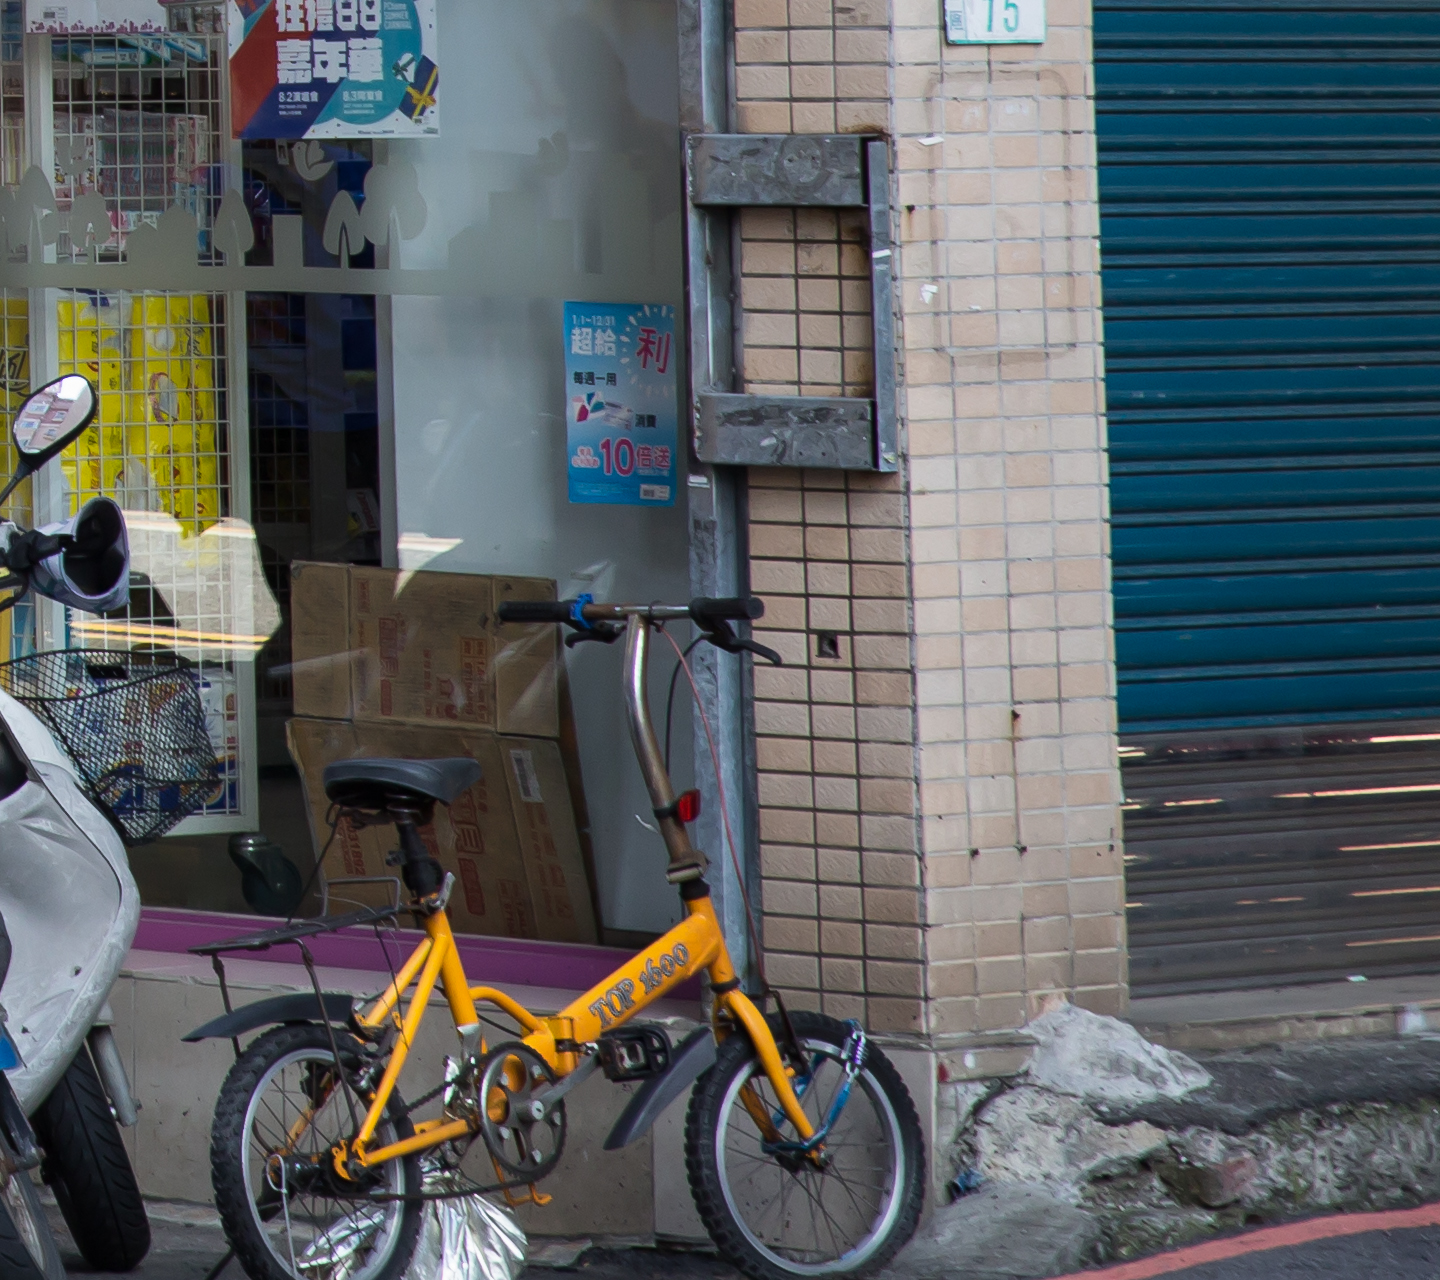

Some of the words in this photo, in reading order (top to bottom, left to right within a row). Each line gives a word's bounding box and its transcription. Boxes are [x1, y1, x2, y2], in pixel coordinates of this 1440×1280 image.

[275, 37, 384, 84] 嘉年華
[571, 326, 618, 357] 超給
[635, 326, 671, 375] 利
[588, 979, 636, 1029] TOP
